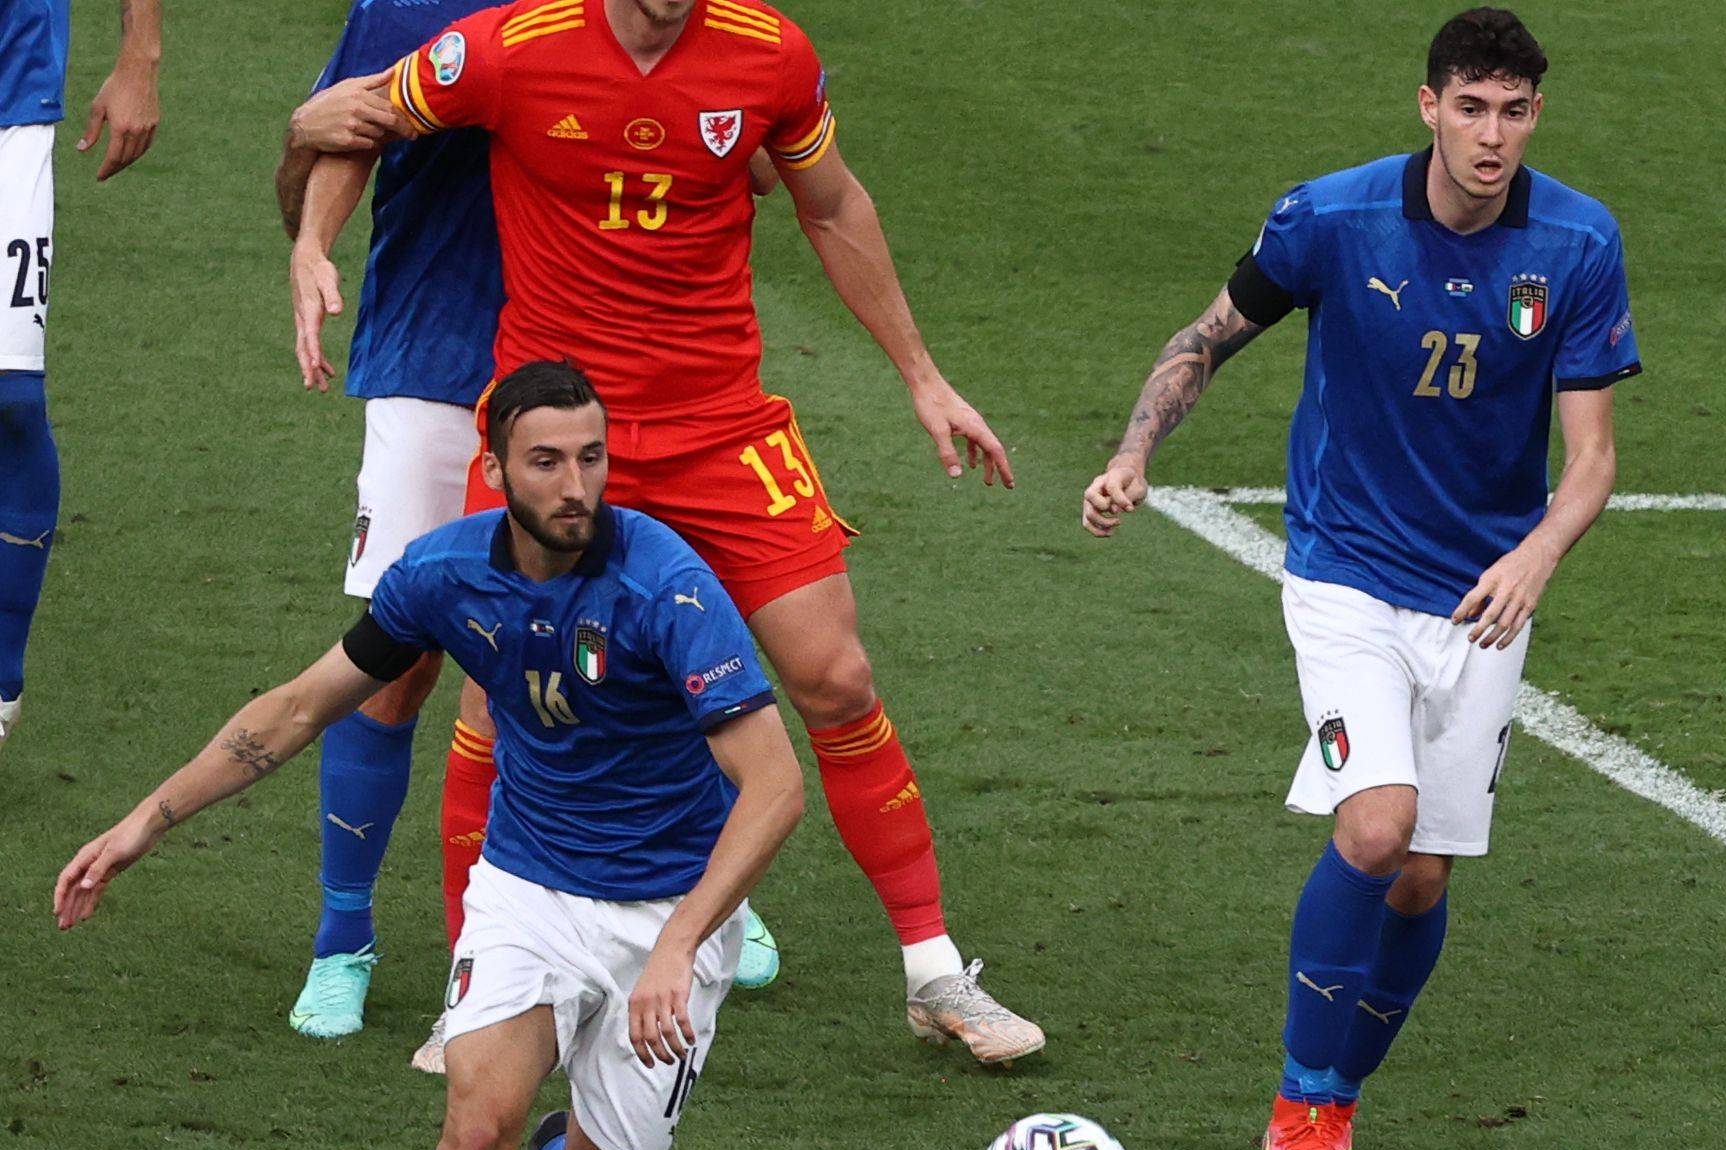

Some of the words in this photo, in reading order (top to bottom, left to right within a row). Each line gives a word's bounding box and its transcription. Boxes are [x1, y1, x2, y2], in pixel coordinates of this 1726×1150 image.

[598, 171, 673, 231] 13
[7, 237, 49, 308] 25
[1512, 286, 1544, 297] ITALIA
[1413, 331, 1482, 399] 23
[739, 430, 815, 517] 13
[524, 669, 580, 728] 16
